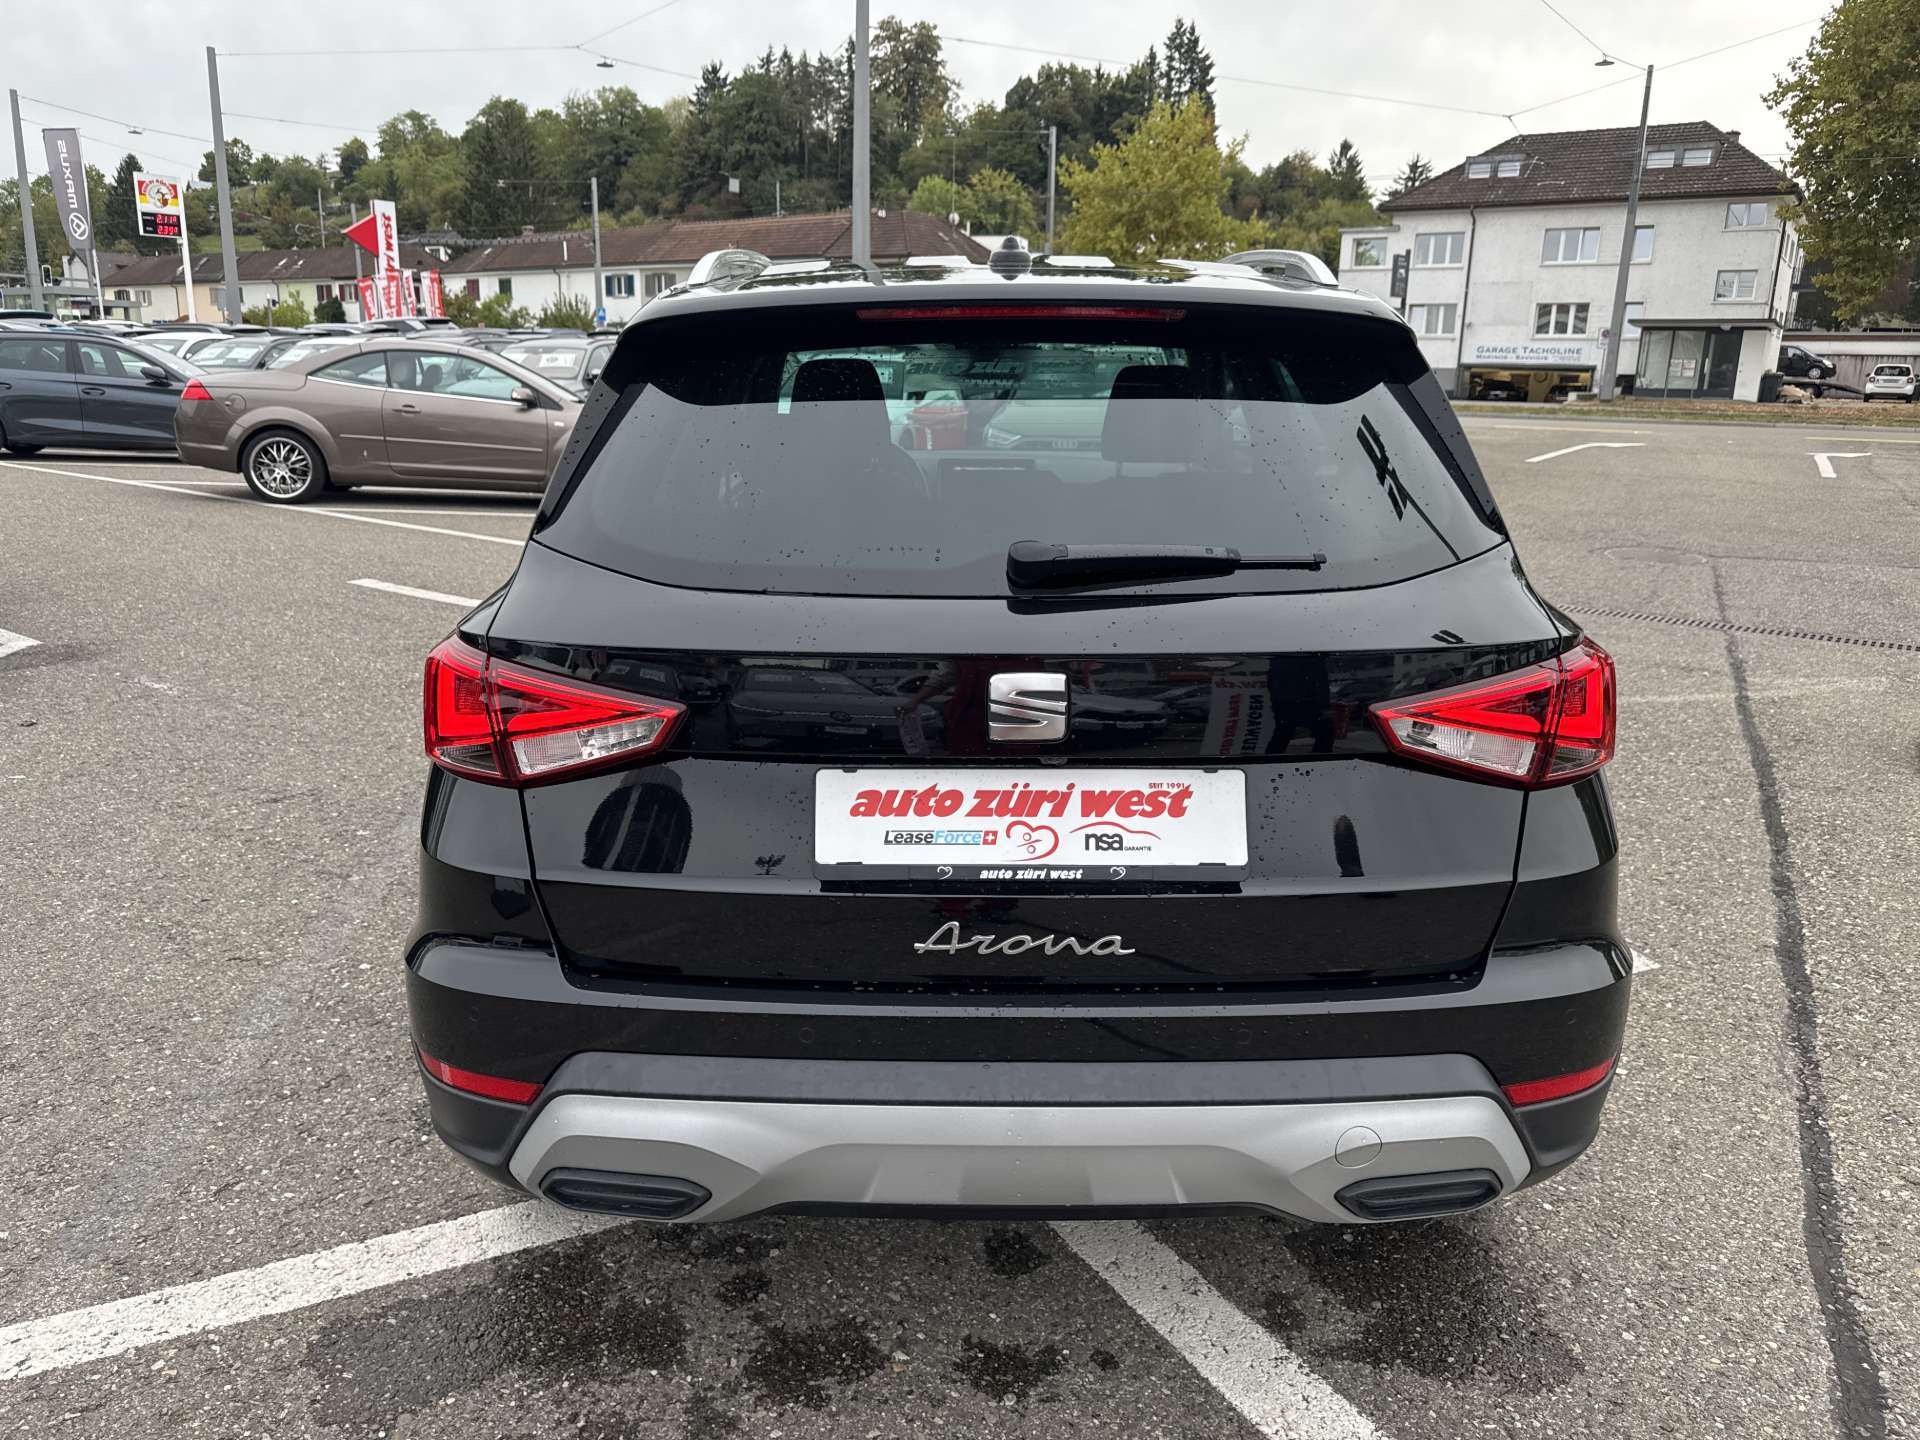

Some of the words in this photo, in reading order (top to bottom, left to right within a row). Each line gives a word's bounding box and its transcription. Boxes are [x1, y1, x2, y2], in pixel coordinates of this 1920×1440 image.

[1476, 345, 1518, 355] GARAGE
[1522, 346, 1583, 356] TACHOLINE
[1166, 782, 1186, 790] 1991
[849, 783, 964, 818] auto
[965, 782, 1076, 818] züri
[1080, 784, 1194, 819] west
[884, 830, 983, 846] LeaseForce
[1084, 833, 1124, 852] nsa
[979, 868, 1013, 880] auto
[1015, 867, 1047, 880] züri
[1050, 868, 1083, 880] west
[913, 921, 1136, 956] Arona
